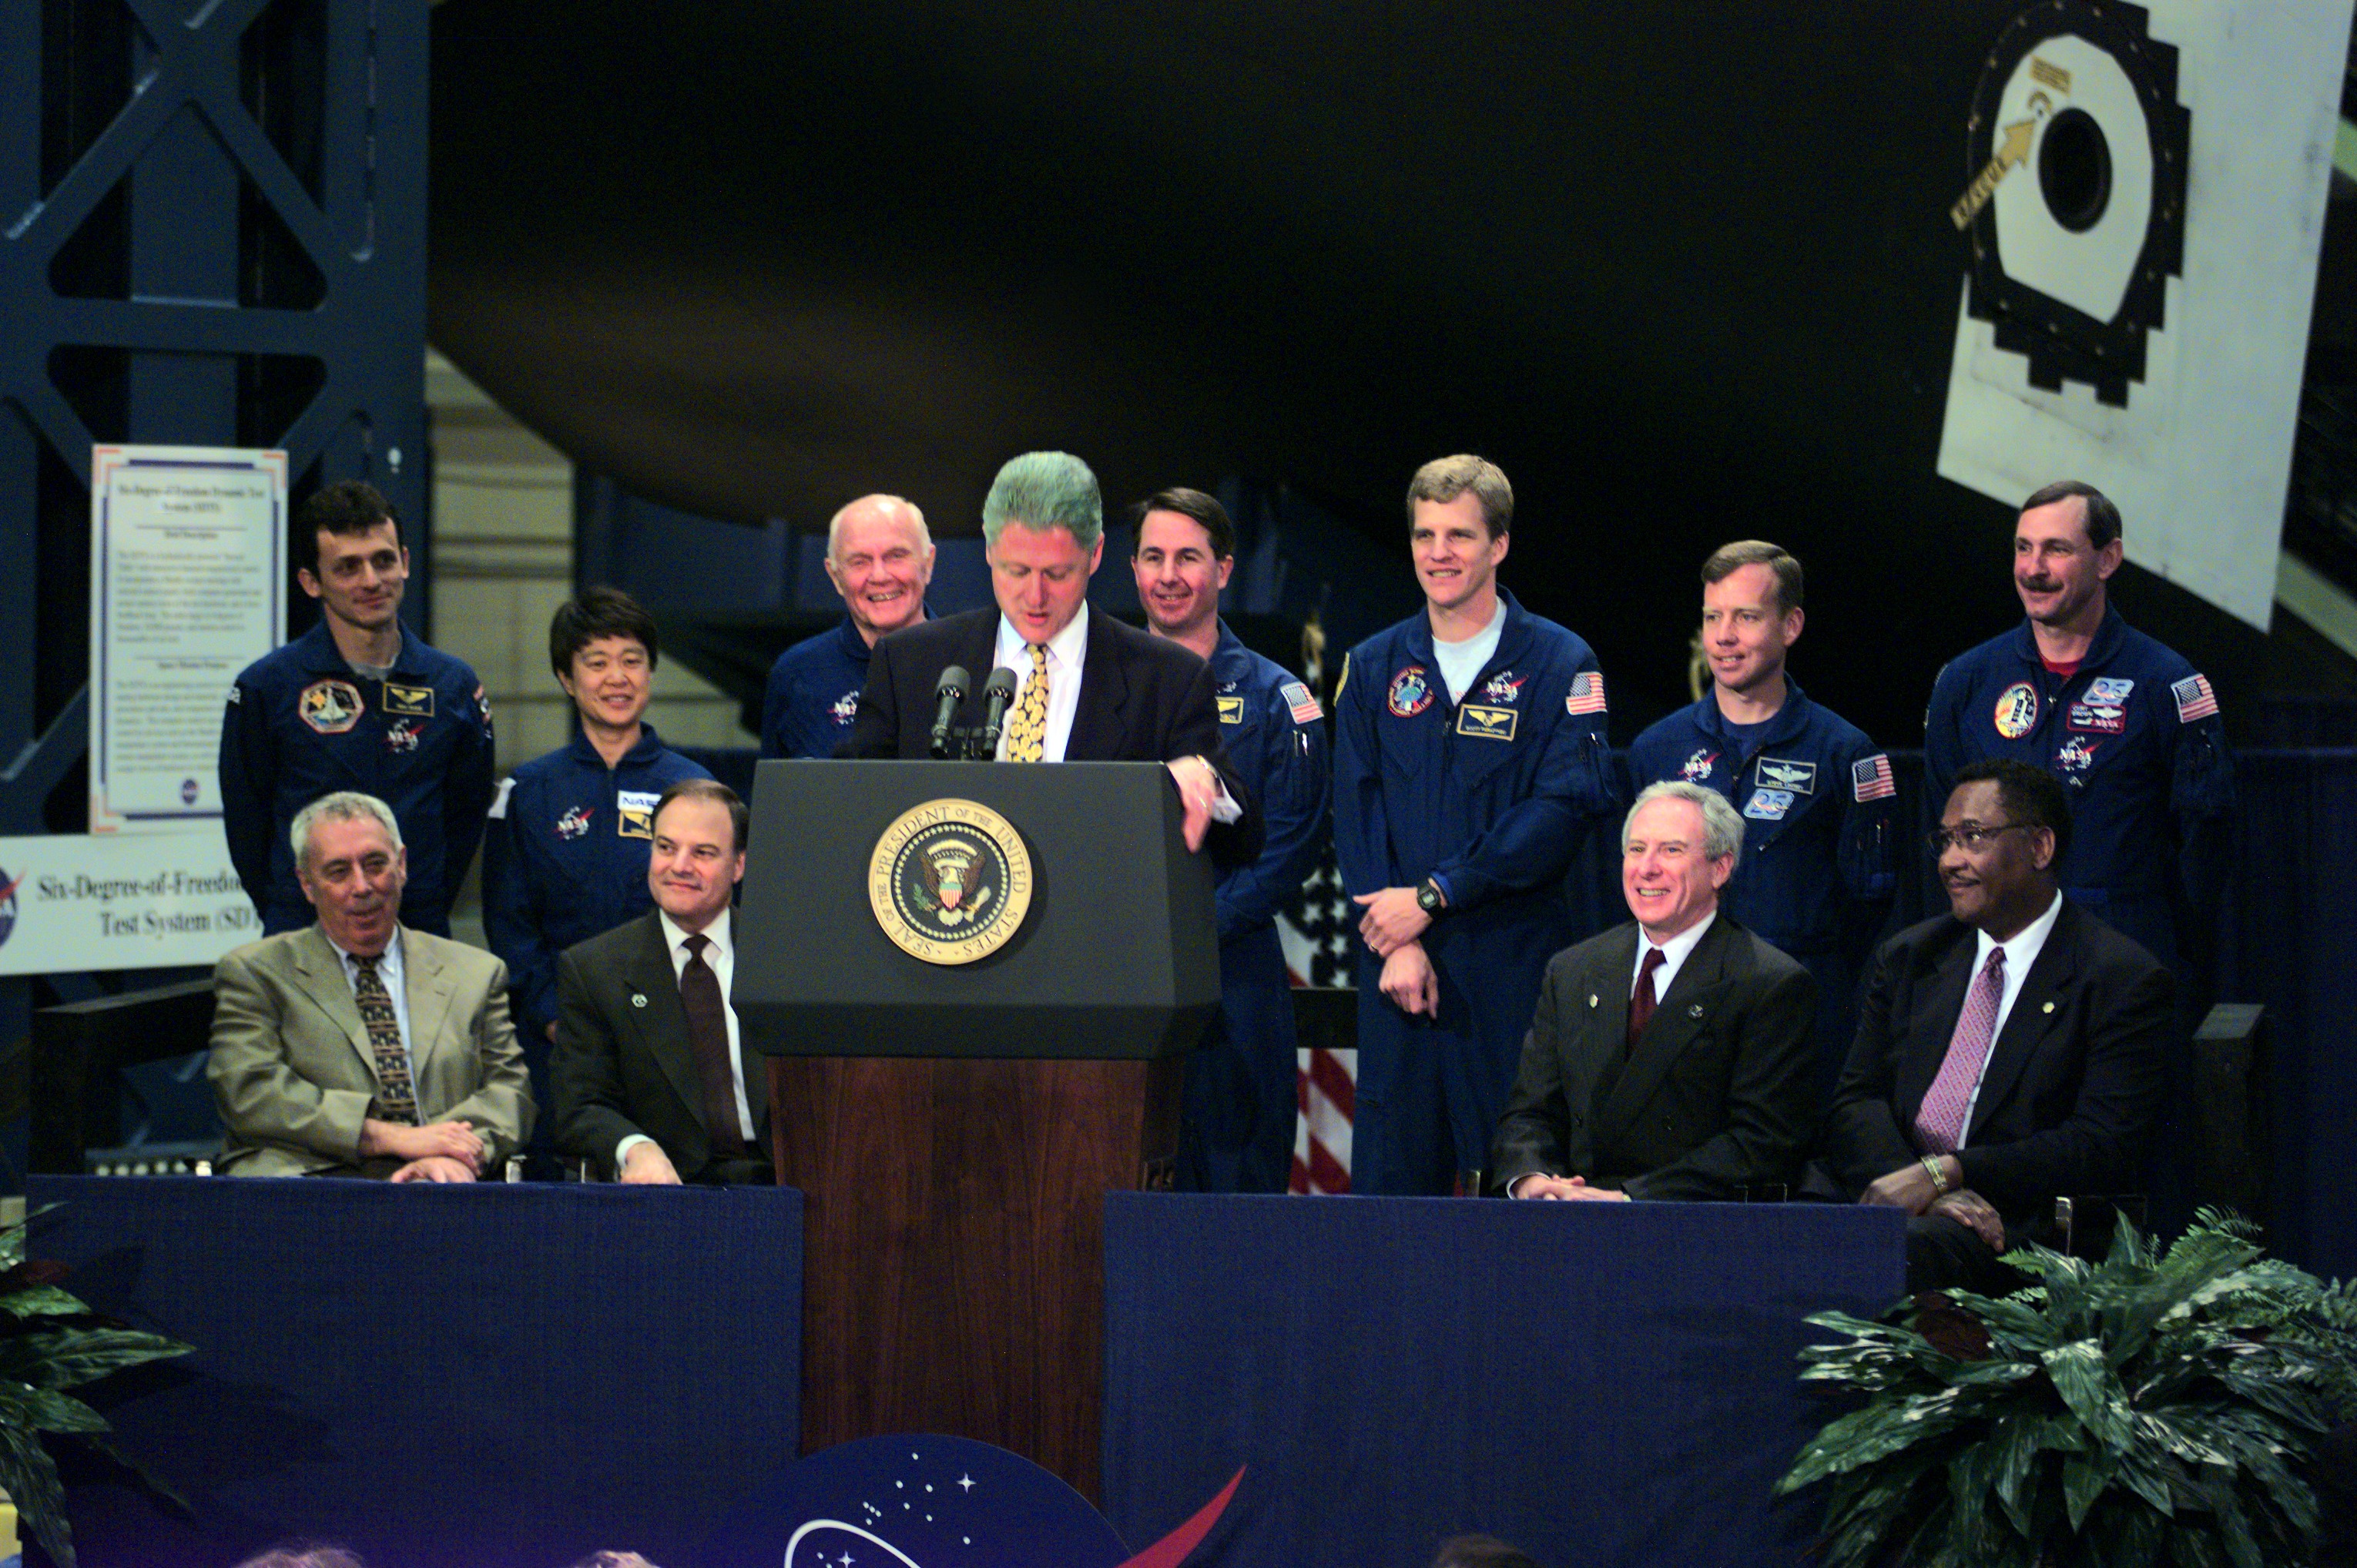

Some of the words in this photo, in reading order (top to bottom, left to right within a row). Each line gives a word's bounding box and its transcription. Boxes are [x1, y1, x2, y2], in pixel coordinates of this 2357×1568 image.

[622, 796, 659, 807] NAS
[955, 808, 969, 819] OF
[974, 812, 993, 828] THE
[877, 806, 950, 876] PRESIDENT
[995, 826, 1027, 893] UNITED
[38, 869, 242, 903] Six-Degree-of-Freedo
[877, 883, 887, 906] THE
[101, 911, 139, 937] Test
[144, 910, 211, 940] System
[882, 909, 895, 922] OF
[895, 920, 934, 957] SEAL
[963, 908, 1018, 957] STATES
